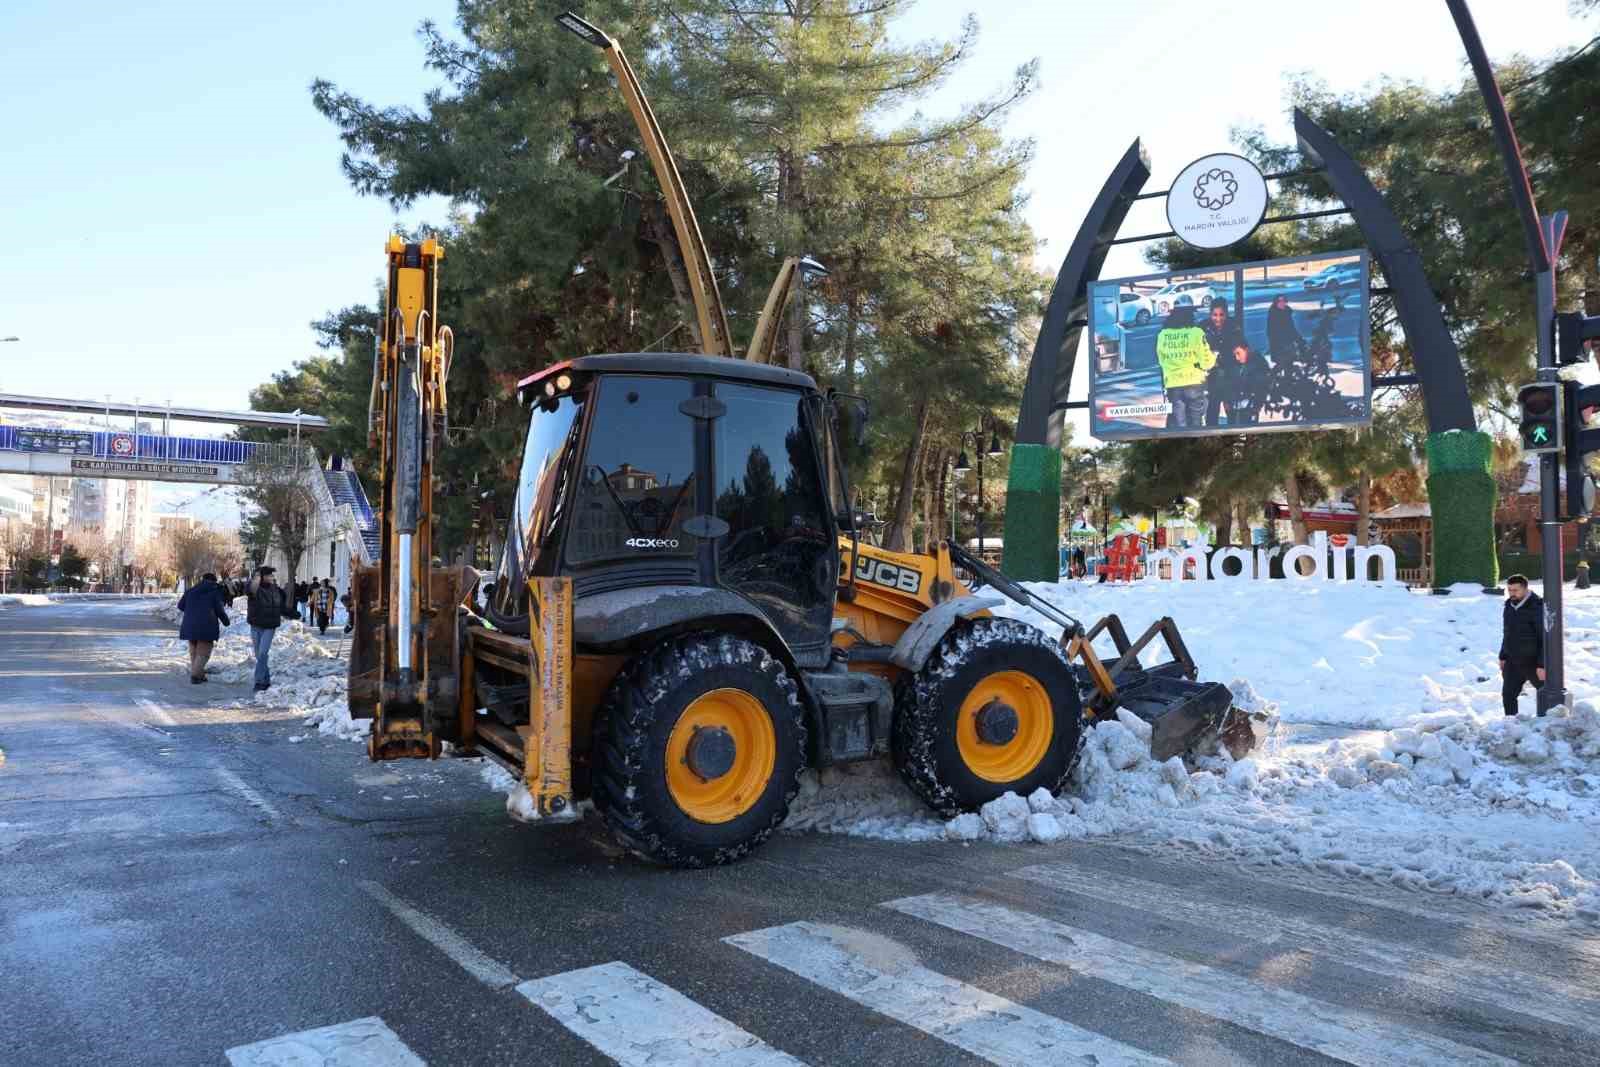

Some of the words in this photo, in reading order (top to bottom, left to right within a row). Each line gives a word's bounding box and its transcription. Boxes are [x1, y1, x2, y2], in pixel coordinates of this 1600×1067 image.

[1109, 408, 1130, 417] YAYA
[625, 537, 679, 549] 4CXeco
[856, 557, 920, 593] JCB
